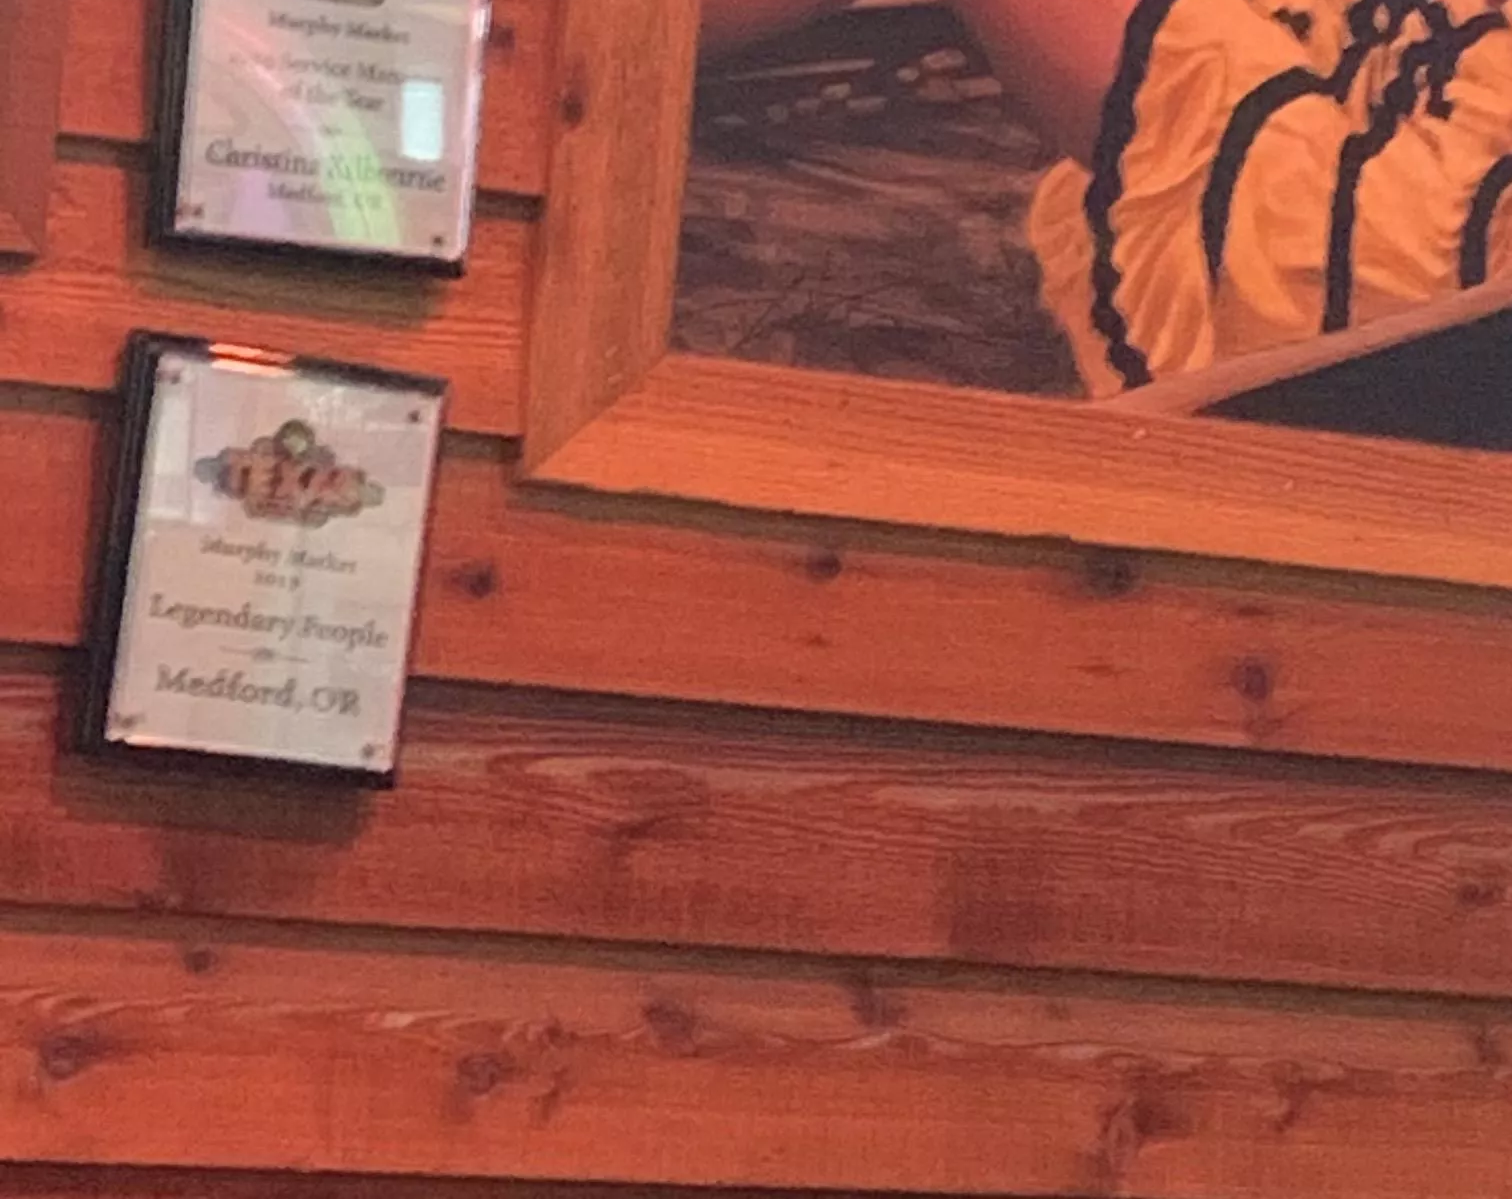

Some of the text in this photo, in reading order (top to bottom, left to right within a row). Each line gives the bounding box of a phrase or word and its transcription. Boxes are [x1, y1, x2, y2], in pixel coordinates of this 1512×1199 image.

[148, 593, 390, 653] Legendary People
[310, 685, 363, 715] OR
